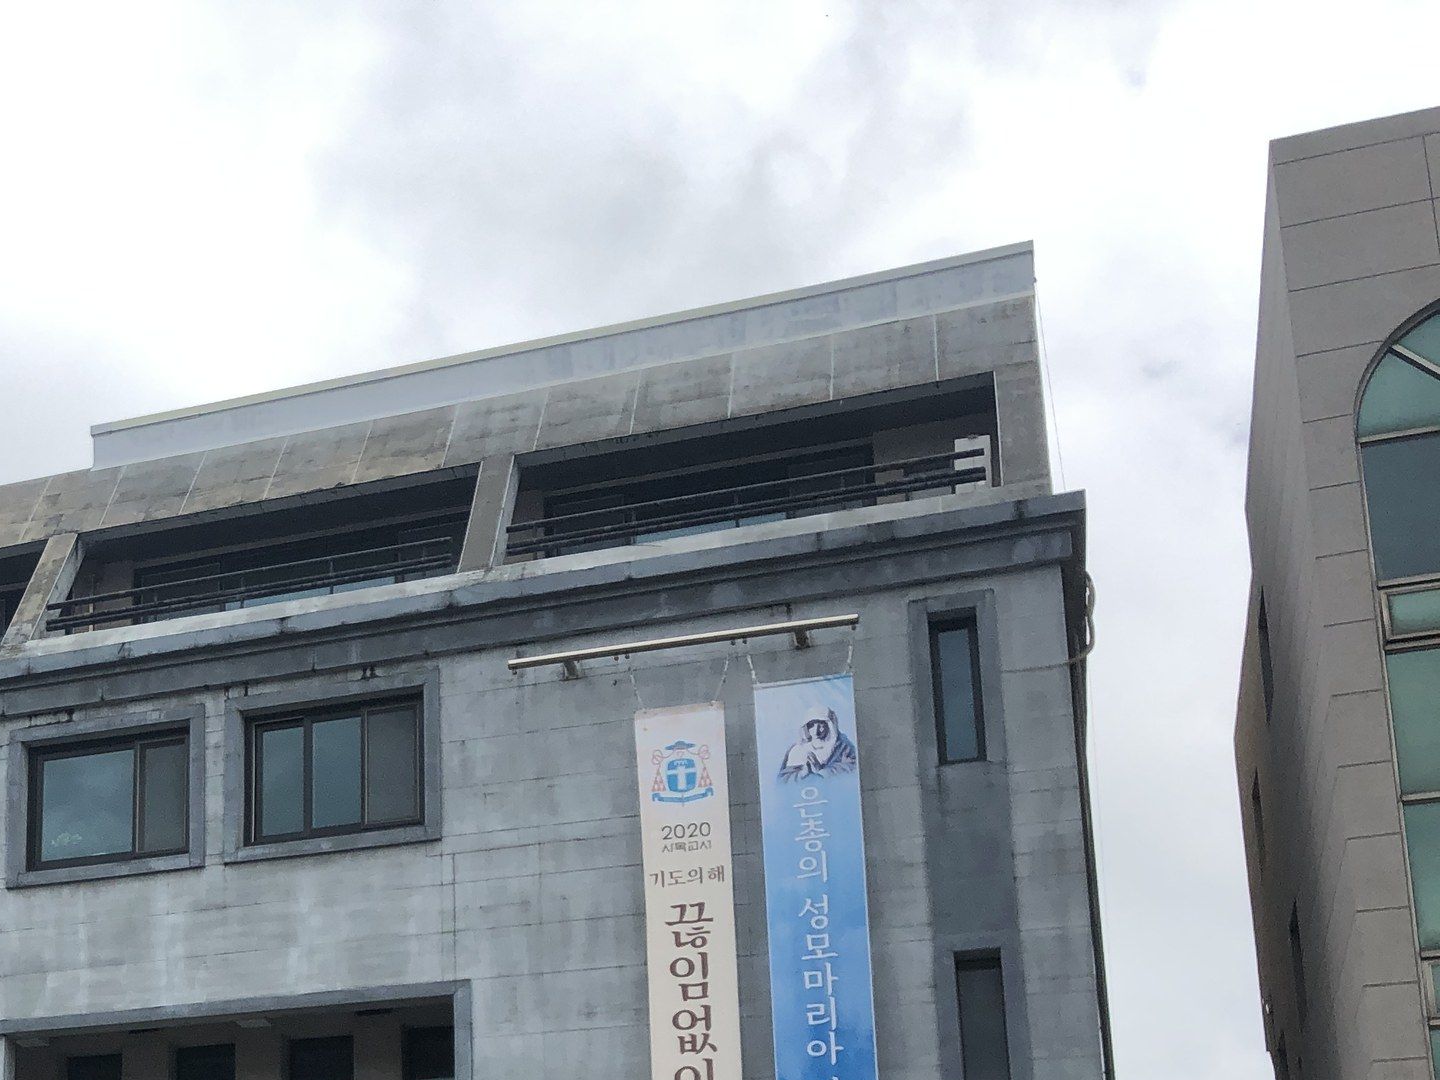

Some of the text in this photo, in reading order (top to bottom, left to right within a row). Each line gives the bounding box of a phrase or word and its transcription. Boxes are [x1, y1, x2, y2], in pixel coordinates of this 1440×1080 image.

[661, 821, 711, 840] 2020
[793, 786, 830, 884] 은총의
[662, 840, 712, 853] 사목교서
[649, 865, 725, 888] 기도의 해
[798, 893, 845, 1067] 성모마리아
